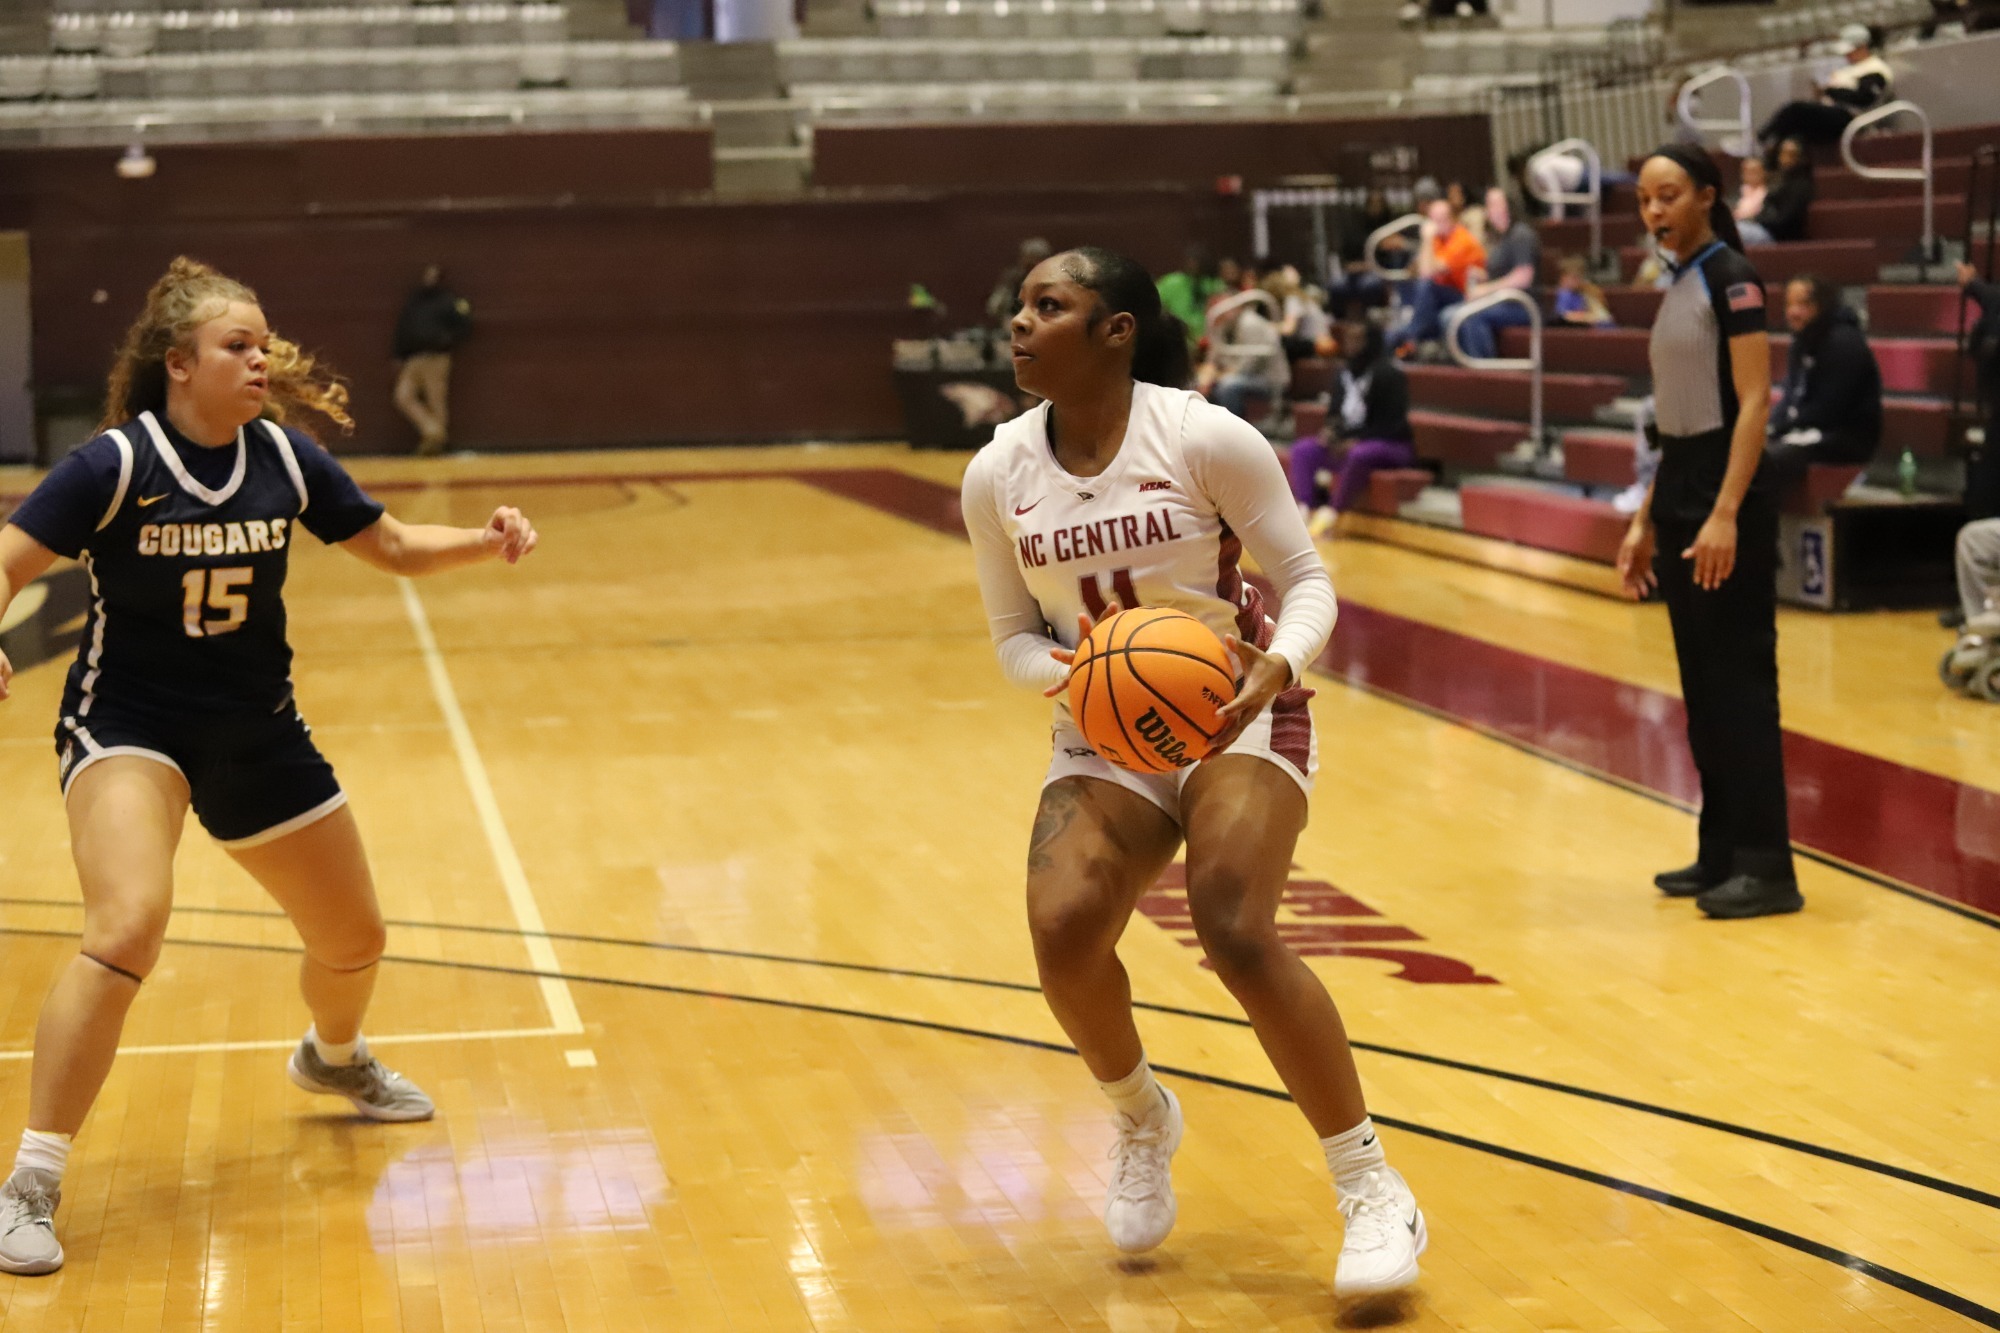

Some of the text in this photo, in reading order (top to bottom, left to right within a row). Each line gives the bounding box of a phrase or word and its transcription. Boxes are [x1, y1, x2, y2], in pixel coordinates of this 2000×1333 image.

[1139, 480, 1171, 492] MEAC
[138, 518, 288, 556] COUGARS
[1019, 508, 1182, 568] NC CENTRAL
[182, 567, 254, 637] 15
[1134, 705, 1199, 768] Wilso
